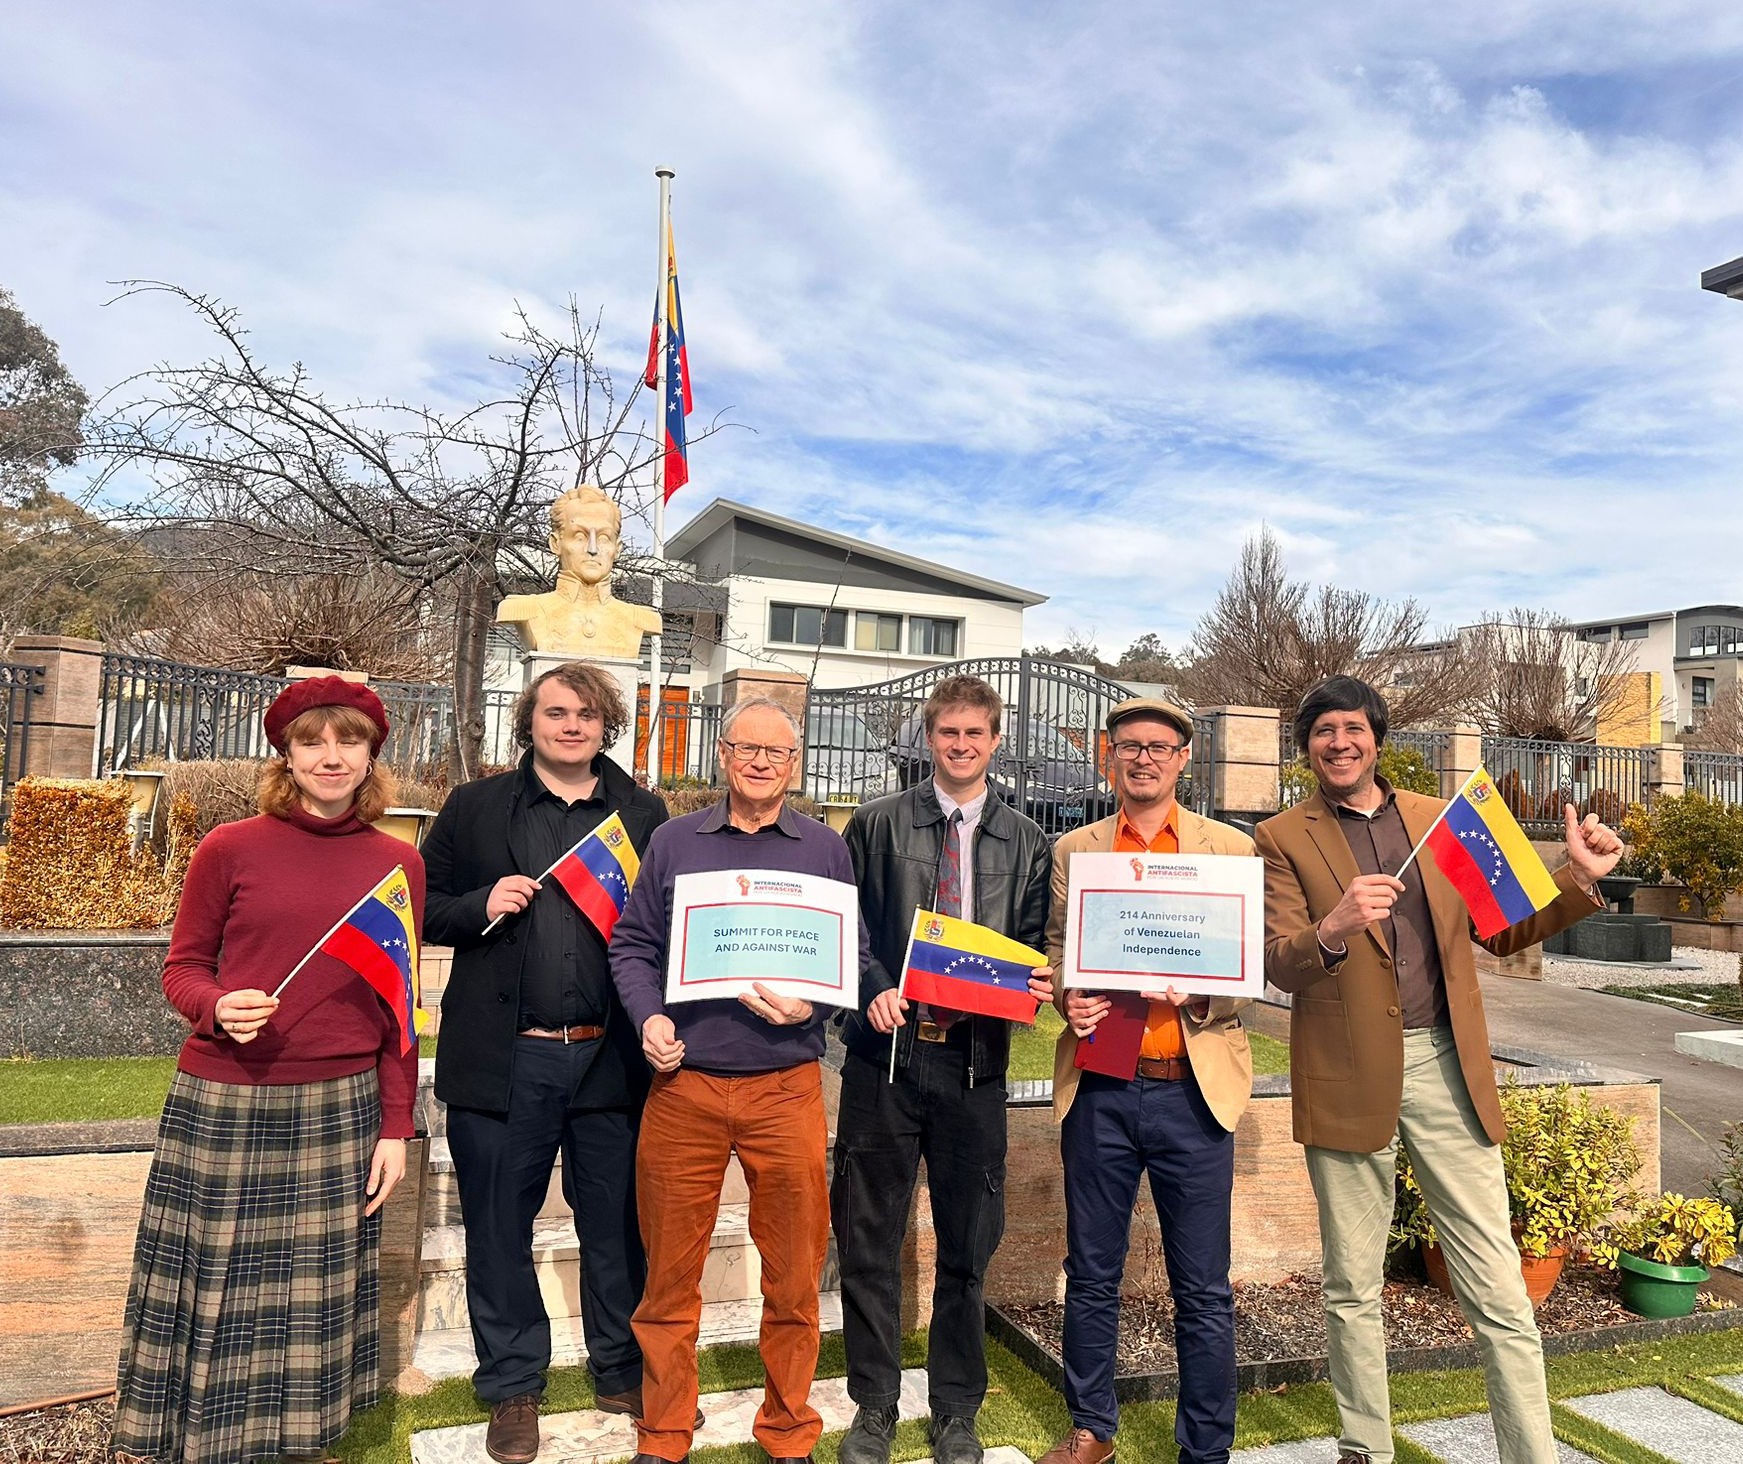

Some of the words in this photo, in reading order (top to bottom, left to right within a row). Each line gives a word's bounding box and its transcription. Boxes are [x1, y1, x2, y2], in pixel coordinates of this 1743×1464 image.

[1119, 910, 1139, 920] 214
[1141, 911, 1206, 925] Anniversary
[714, 927, 758, 938] SUMMIT
[760, 927, 783, 937] FOR
[785, 929, 820, 942] PEACE
[1124, 927, 1136, 936] of
[1137, 927, 1200, 939] Venezuelan
[715, 943, 739, 953] AND
[741, 943, 790, 953] AGAINST
[792, 945, 817, 956] WAR
[1122, 944, 1201, 957] Independence
